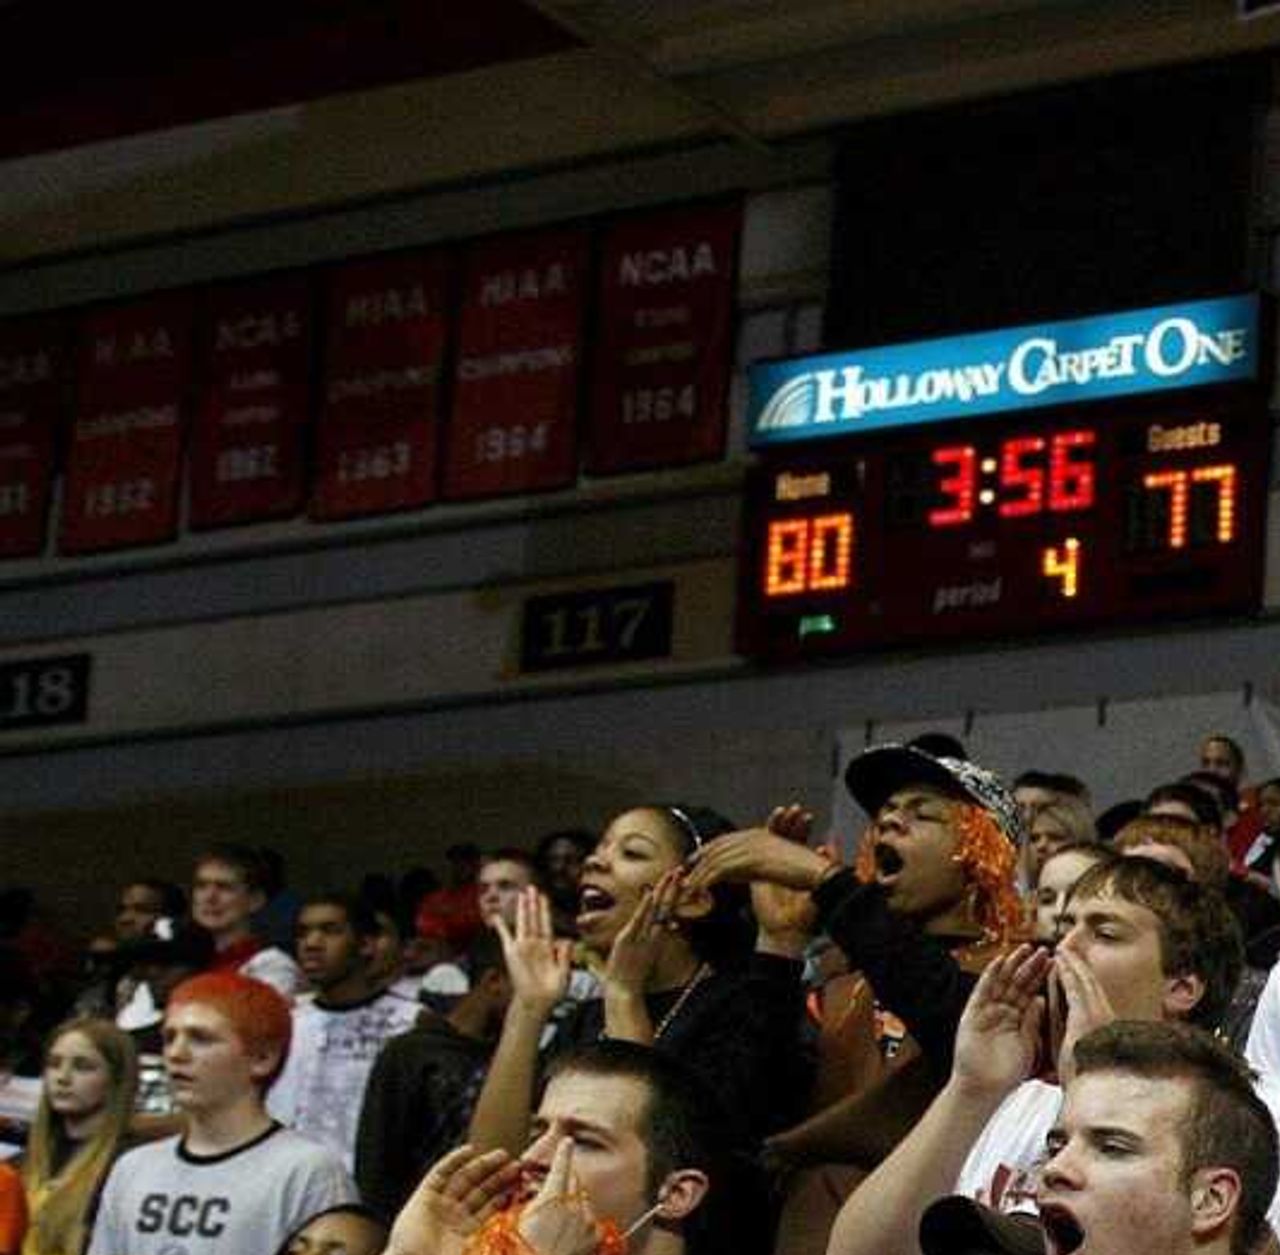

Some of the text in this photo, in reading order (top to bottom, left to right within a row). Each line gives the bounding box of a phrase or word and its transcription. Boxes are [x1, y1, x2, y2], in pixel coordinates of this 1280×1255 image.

[621, 241, 717, 288] NCAA
[1147, 424, 1222, 453] Guests
[927, 430, 1099, 528] 3:56
[1143, 464, 1237, 548] 77
[765, 513, 855, 596] 80
[1043, 538, 1079, 598] 4
[543, 603, 655, 657] 117
[136, 1193, 231, 1237] SCC
